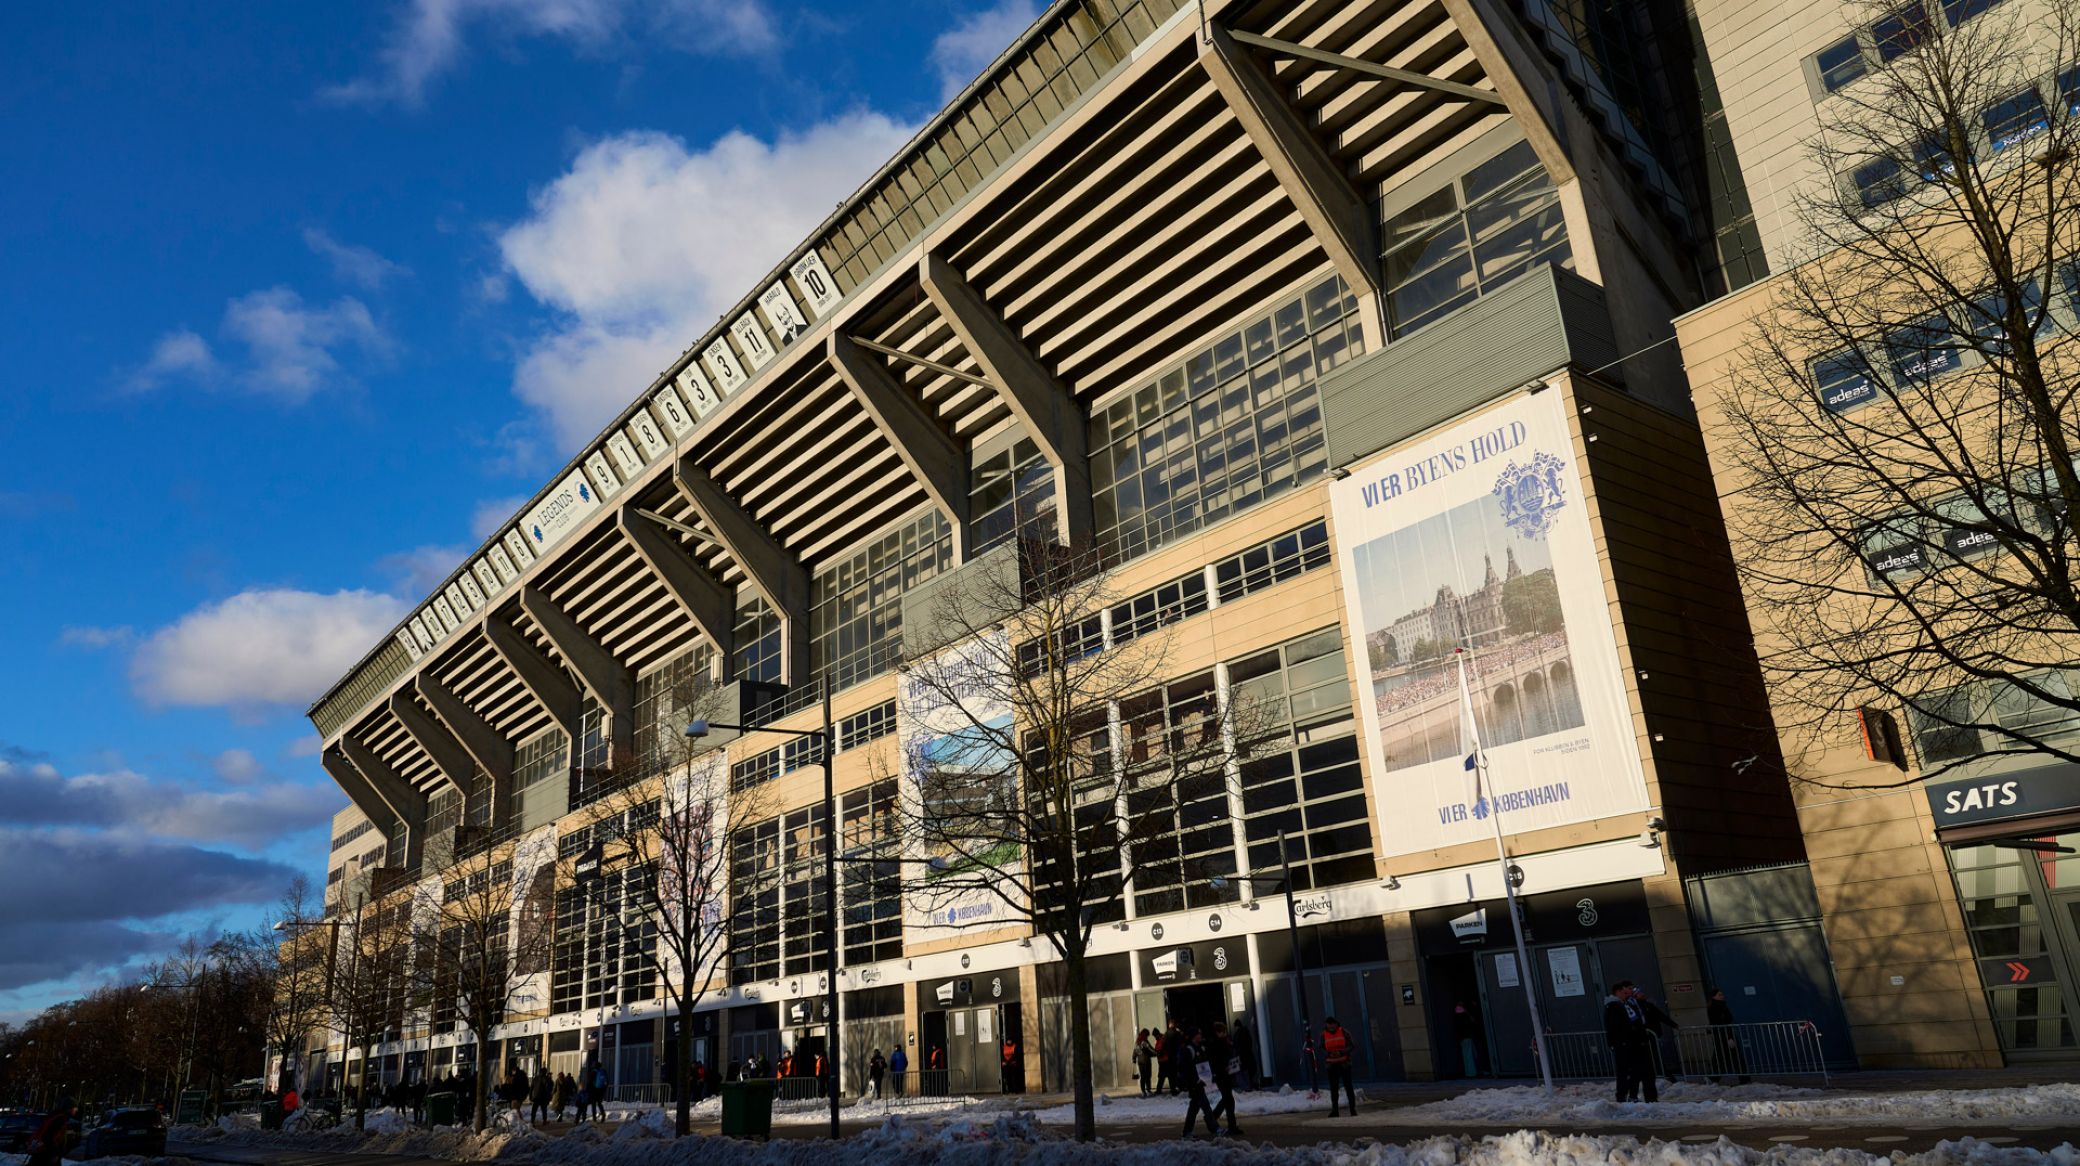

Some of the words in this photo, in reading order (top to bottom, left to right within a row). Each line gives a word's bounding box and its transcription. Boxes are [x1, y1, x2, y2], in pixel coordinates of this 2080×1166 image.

[805, 270, 826, 299] 10
[764, 287, 781, 305] HARALD
[745, 328, 763, 353] 11
[717, 355, 732, 378] 3
[691, 379, 705, 401] 3
[1829, 384, 1869, 405] adeas
[666, 402, 680, 423] 6
[642, 425, 655, 444] 8
[619, 446, 631, 463] 1
[1361, 481, 1379, 508] VI
[1380, 473, 1402, 501] ER
[1403, 445, 1467, 492] BYENS
[1469, 420, 1526, 465] HOLD
[597, 465, 609, 483] 9
[537, 489, 574, 527] LEGENDS
[556, 513, 570, 528] CLUB
[514, 541, 525, 557] 6
[1957, 531, 1996, 549] adea
[1876, 552, 1920, 571] adeas
[1438, 807, 1451, 825] VI
[1452, 803, 1468, 822] ER
[1493, 781, 1571, 814] KØBENHAVN
[1944, 781, 2018, 814] SATS
[1293, 897, 1333, 917] Carlsberg
[1456, 921, 1483, 929] PARKEN
